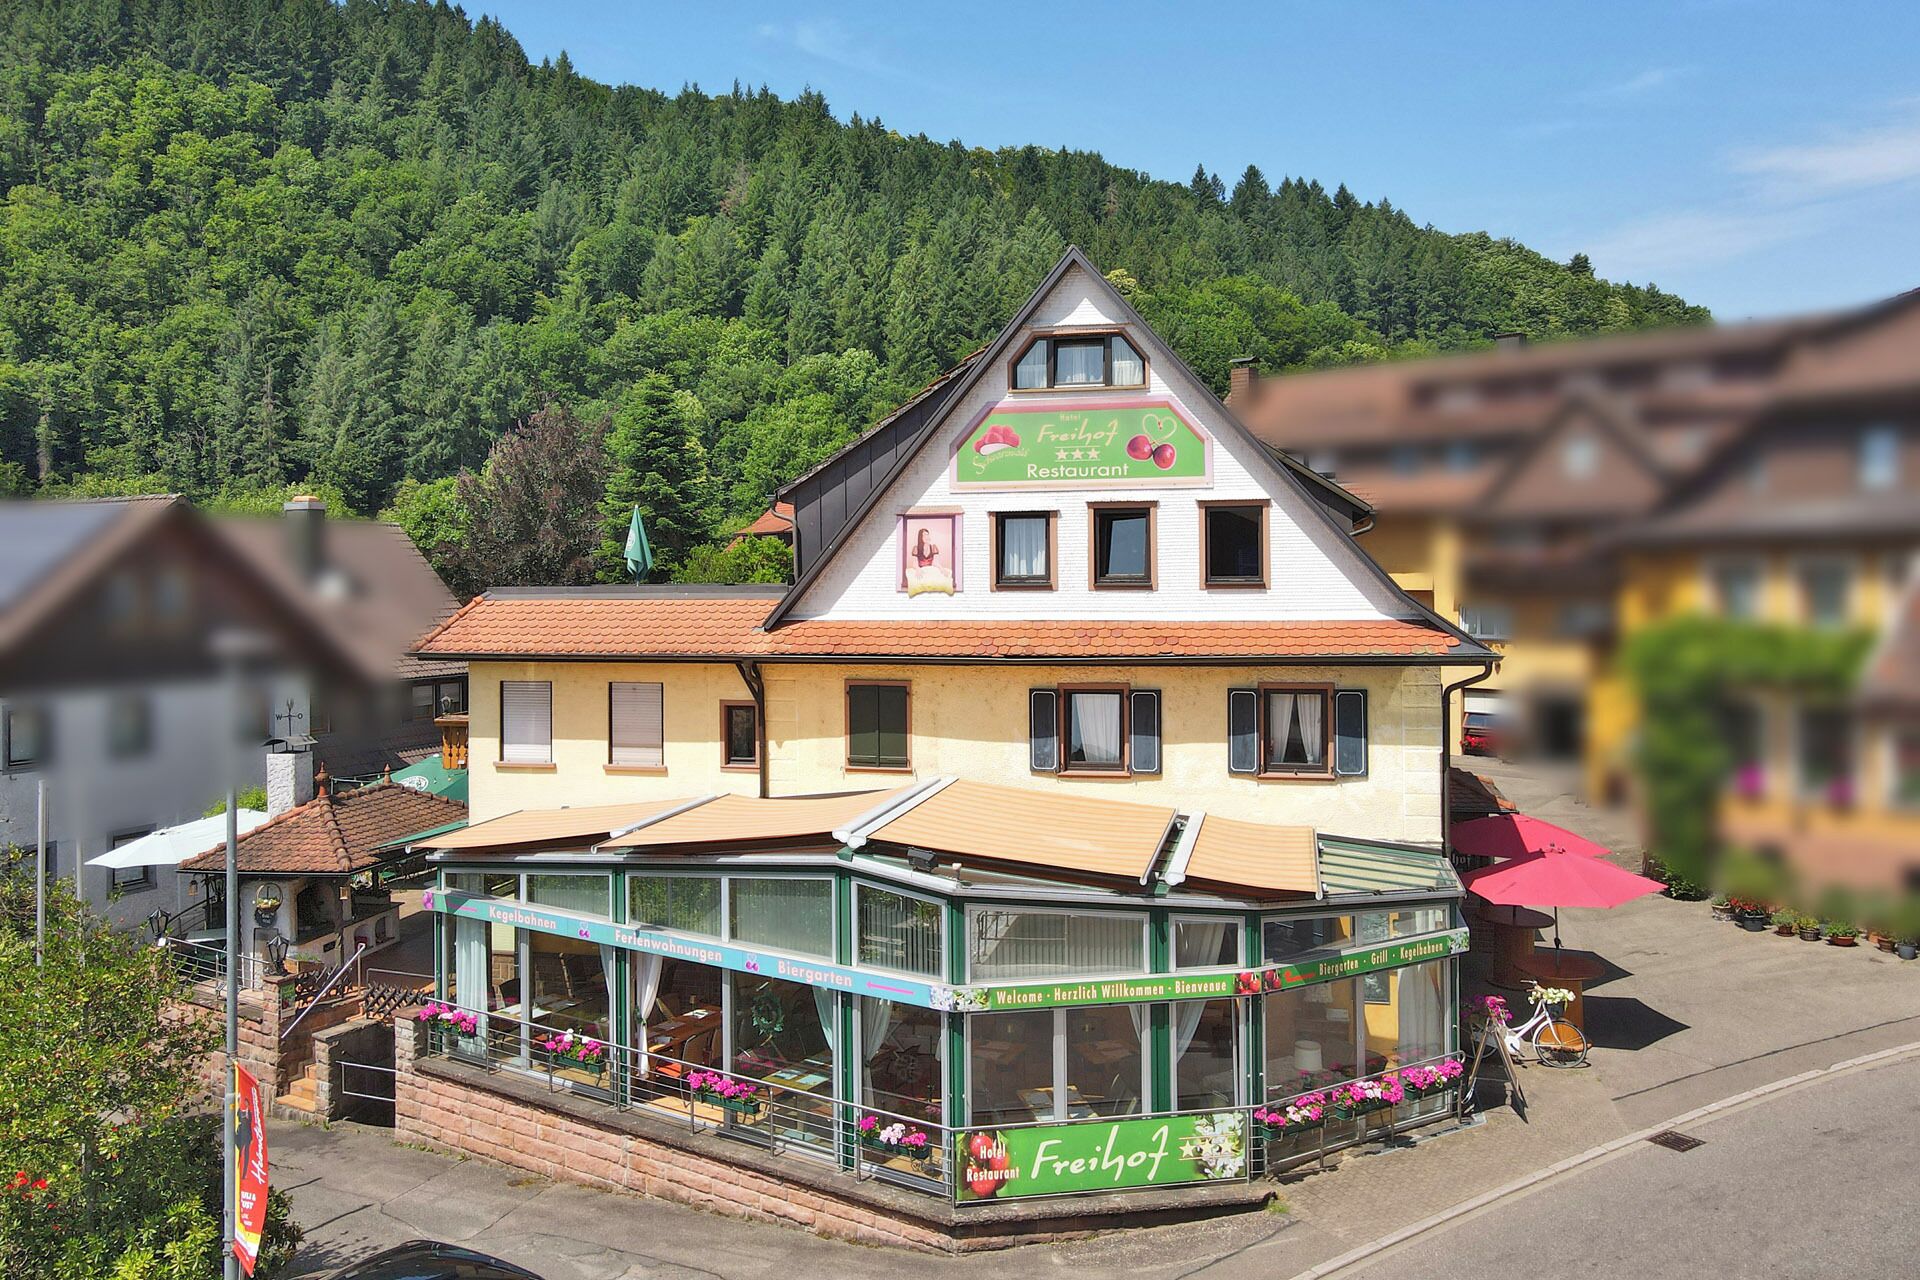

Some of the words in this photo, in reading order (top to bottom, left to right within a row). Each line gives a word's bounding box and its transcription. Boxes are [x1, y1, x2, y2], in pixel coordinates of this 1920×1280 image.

[1037, 418, 1119, 446] Freihof
[1027, 463, 1129, 479] Restaurant
[489, 905, 556, 930] Kegelbahnen
[615, 927, 722, 963] Ferienwohnungen
[1319, 959, 1359, 976] Biergarten
[1371, 949, 1388, 964] Grill
[1400, 942, 1443, 961] Kegelbahnen
[778, 960, 852, 988] Biergarten
[996, 990, 1043, 1004] Welcome
[1054, 985, 1097, 1001] Herzlich
[1101, 980, 1164, 999] Willkommen
[1175, 980, 1227, 994] Bienvenue
[980, 1143, 1006, 1160] Hotel
[1031, 1124, 1169, 1182] Freihof
[966, 1167, 1020, 1182] Restaurant
